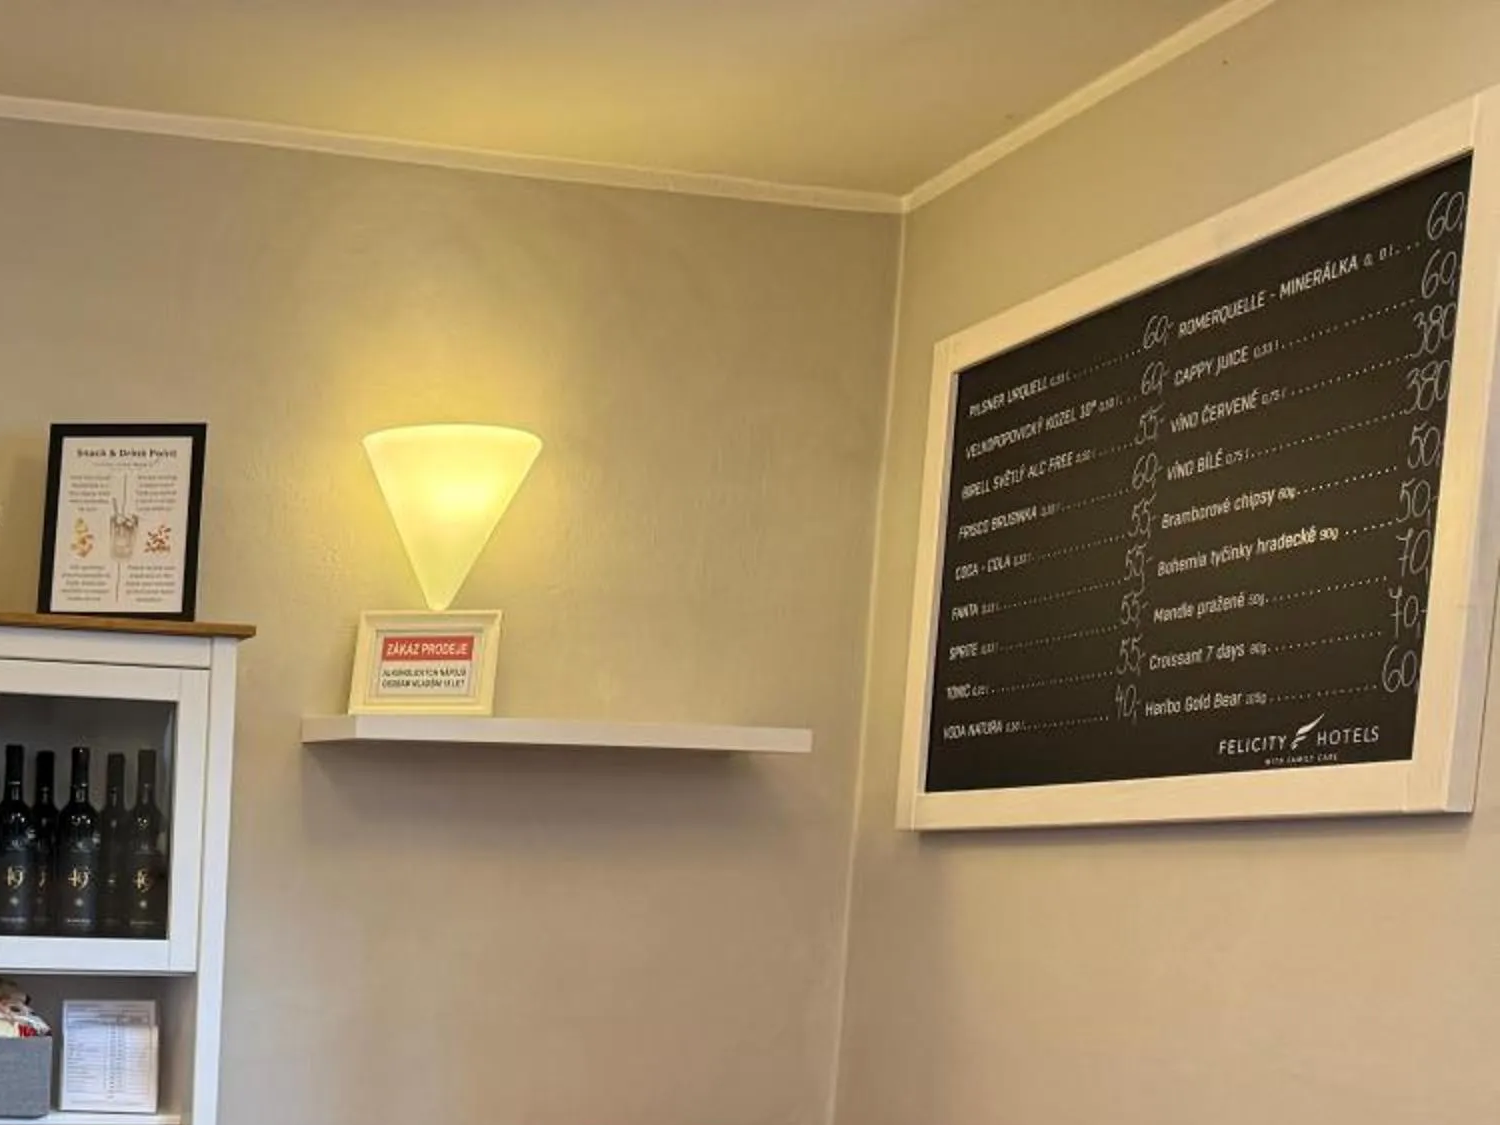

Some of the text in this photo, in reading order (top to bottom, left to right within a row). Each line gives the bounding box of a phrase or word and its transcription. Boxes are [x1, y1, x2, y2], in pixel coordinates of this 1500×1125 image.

[1178, 290, 1266, 338] ROMERQUELLE
[1279, 253, 1359, 300] MINERÁLKA
[1174, 358, 1213, 387] CAPPY
[1215, 346, 1249, 376] JUICE
[968, 392, 1005, 418] PILSNER
[1045, 408, 1076, 431] KOZEL
[1170, 411, 1198, 433] VÍNO
[1201, 387, 1260, 424] ČERVENÉ
[1167, 460, 1195, 480] VÍNO
[1197, 448, 1223, 472] BÍLÉ
[1162, 498, 1231, 529] Bramborové
[1233, 488, 1276, 511] chipsy
[1157, 550, 1207, 577] Bohemia
[1210, 543, 1254, 567] tyčinky
[1256, 525, 1316, 554] hradecké
[1153, 602, 1193, 623] Mandle
[1197, 591, 1245, 619] pražené
[386, 642, 468, 656] ZÁKAZ PRODEJE
[1149, 647, 1203, 671] Croissant
[1206, 645, 1213, 661] 7
[1216, 641, 1245, 662] days
[1145, 699, 1181, 717] Haribo
[1185, 694, 1211, 712] Gold
[1213, 692, 1243, 708] Bear
[1218, 725, 1380, 756] FELICITY HOTELS
